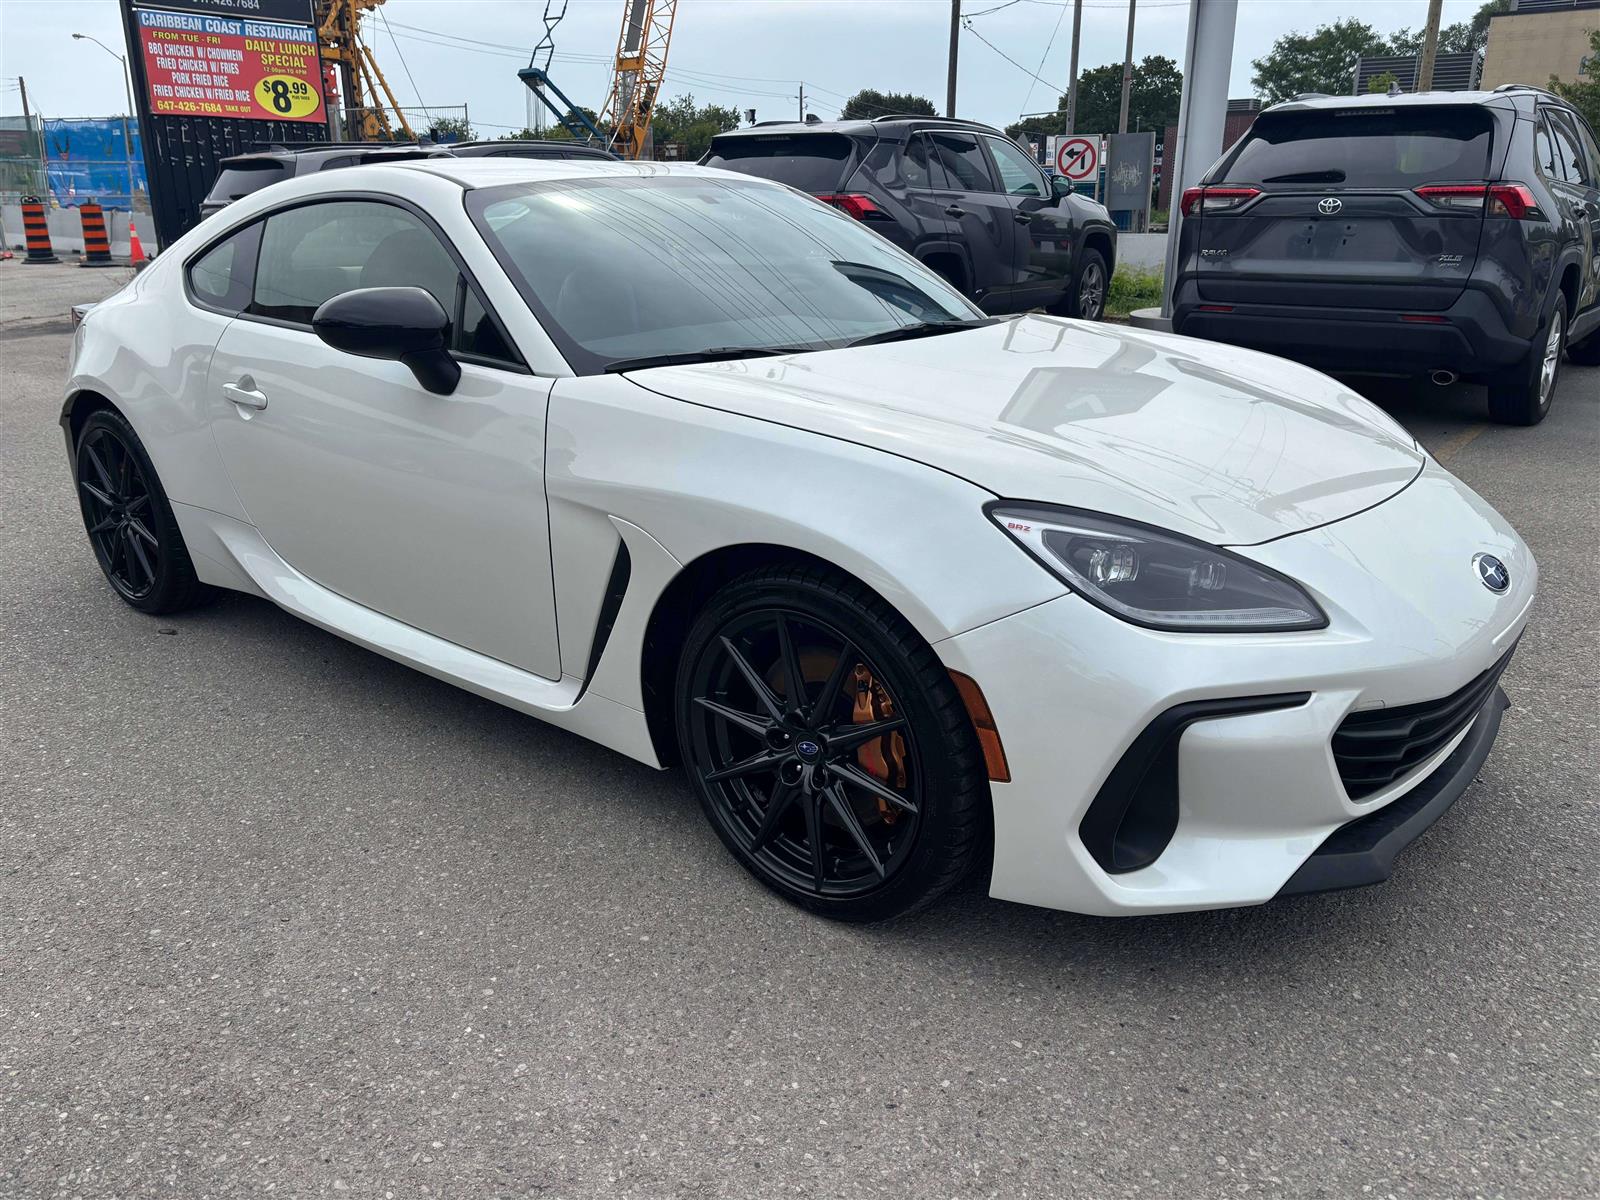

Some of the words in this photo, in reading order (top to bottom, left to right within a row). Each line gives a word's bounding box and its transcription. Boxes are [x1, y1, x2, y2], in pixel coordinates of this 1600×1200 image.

[141, 12, 202, 31] CARIBBEAN
[205, 19, 242, 35] COAST
[244, 23, 313, 42] RESTAURANT
[152, 30, 179, 40] FROM
[181, 33, 199, 42] TUE
[206, 35, 221, 44] FRI
[148, 42, 163, 55] BBQ
[164, 43, 195, 58] CHICKEN
[245, 39, 276, 53] DAILY
[279, 42, 316, 57] LUNCH
[156, 57, 177, 69] FRIED
[178, 58, 208, 72] CHICKEN
[220, 62, 240, 74] FRIES
[261, 53, 307, 68] SPECIAL
[171, 72, 191, 84] PORK
[192, 73, 212, 86] FRIED
[213, 75, 229, 87] RICE
[153, 84, 174, 97] FRIED
[175, 85, 205, 99] CHICKEN
[235, 90, 251, 102] RICE
[262, 79, 308, 113] $8.99
[157, 100, 222, 112] 647-426-7684
[224, 104, 239, 112] TAKE
[1007, 522, 1031, 532] BRZ
